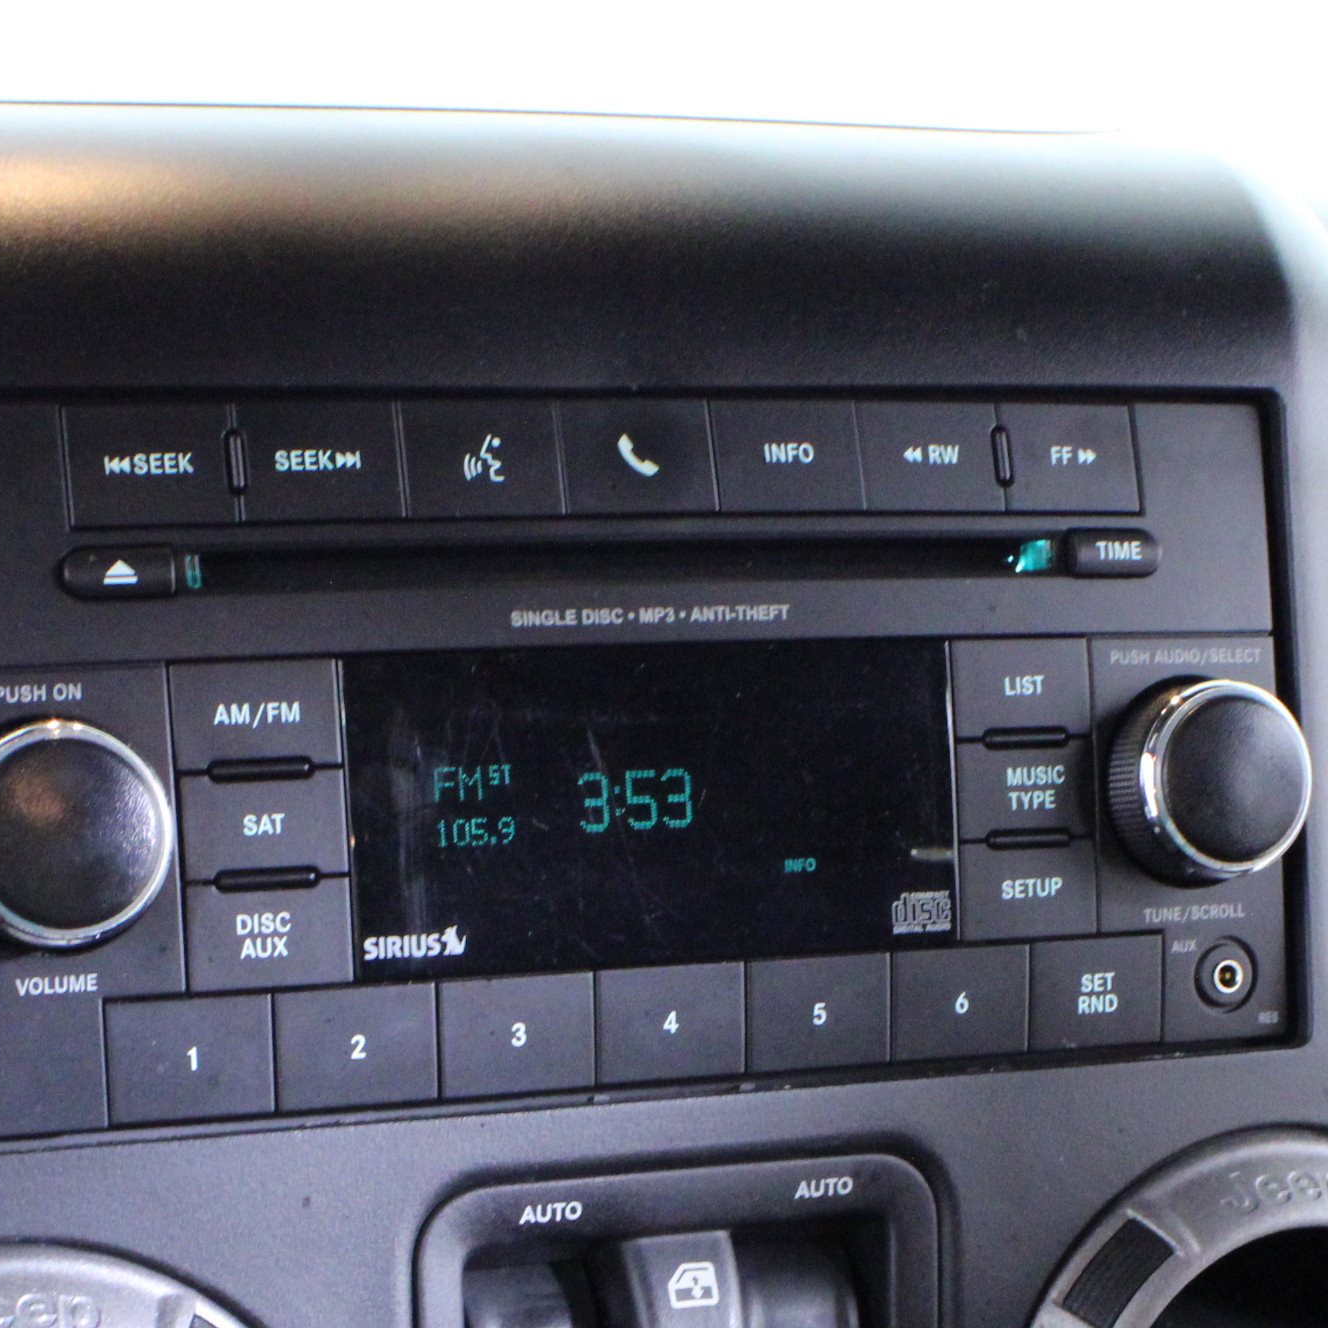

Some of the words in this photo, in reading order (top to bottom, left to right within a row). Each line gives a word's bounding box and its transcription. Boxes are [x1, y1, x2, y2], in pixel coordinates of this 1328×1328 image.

[133, 452, 194, 475] SEEK
[275, 448, 335, 471] SEEK
[764, 442, 814, 464] INFO
[928, 443, 959, 465] RW
[1050, 446, 1075, 466] FF
[1095, 539, 1142, 561] TIME
[510, 609, 577, 627] SINGLE
[581, 607, 624, 625] DISC
[638, 606, 676, 624] MP3
[690, 604, 790, 623] ANTI-THEFT
[1109, 647, 1150, 666] PUSH
[1153, 646, 1262, 666] AUDIO/SELECT
[52, 682, 83, 702] ON
[1004, 675, 1044, 696] LIST
[213, 701, 301, 726] AM/FM
[433, 765, 483, 803] FM
[1005, 764, 1066, 787] MUSIC
[576, 768, 694, 834] 3:53
[1008, 788, 1056, 810] TYPE
[243, 812, 286, 837] SAT
[436, 815, 516, 848] 105.9
[784, 857, 817, 872] INFO
[1001, 877, 1063, 901] SETUP
[236, 911, 292, 936] DISC
[1143, 902, 1247, 924] TUNE/SCROLL
[240, 935, 289, 960] AUX
[363, 932, 442, 961] SIRIUS
[15, 972, 98, 997] VOLUME
[1080, 971, 1115, 994] SET
[811, 1001, 828, 1026] 5
[954, 991, 970, 1016] 6
[1076, 992, 1119, 1015] RND
[662, 1010, 680, 1036] 4
[349, 1034, 367, 1061] 2
[510, 1022, 527, 1049] 3
[186, 1046, 199, 1072] 1
[794, 1175, 854, 1201] AUTO
[519, 1200, 583, 1226] AUTO
